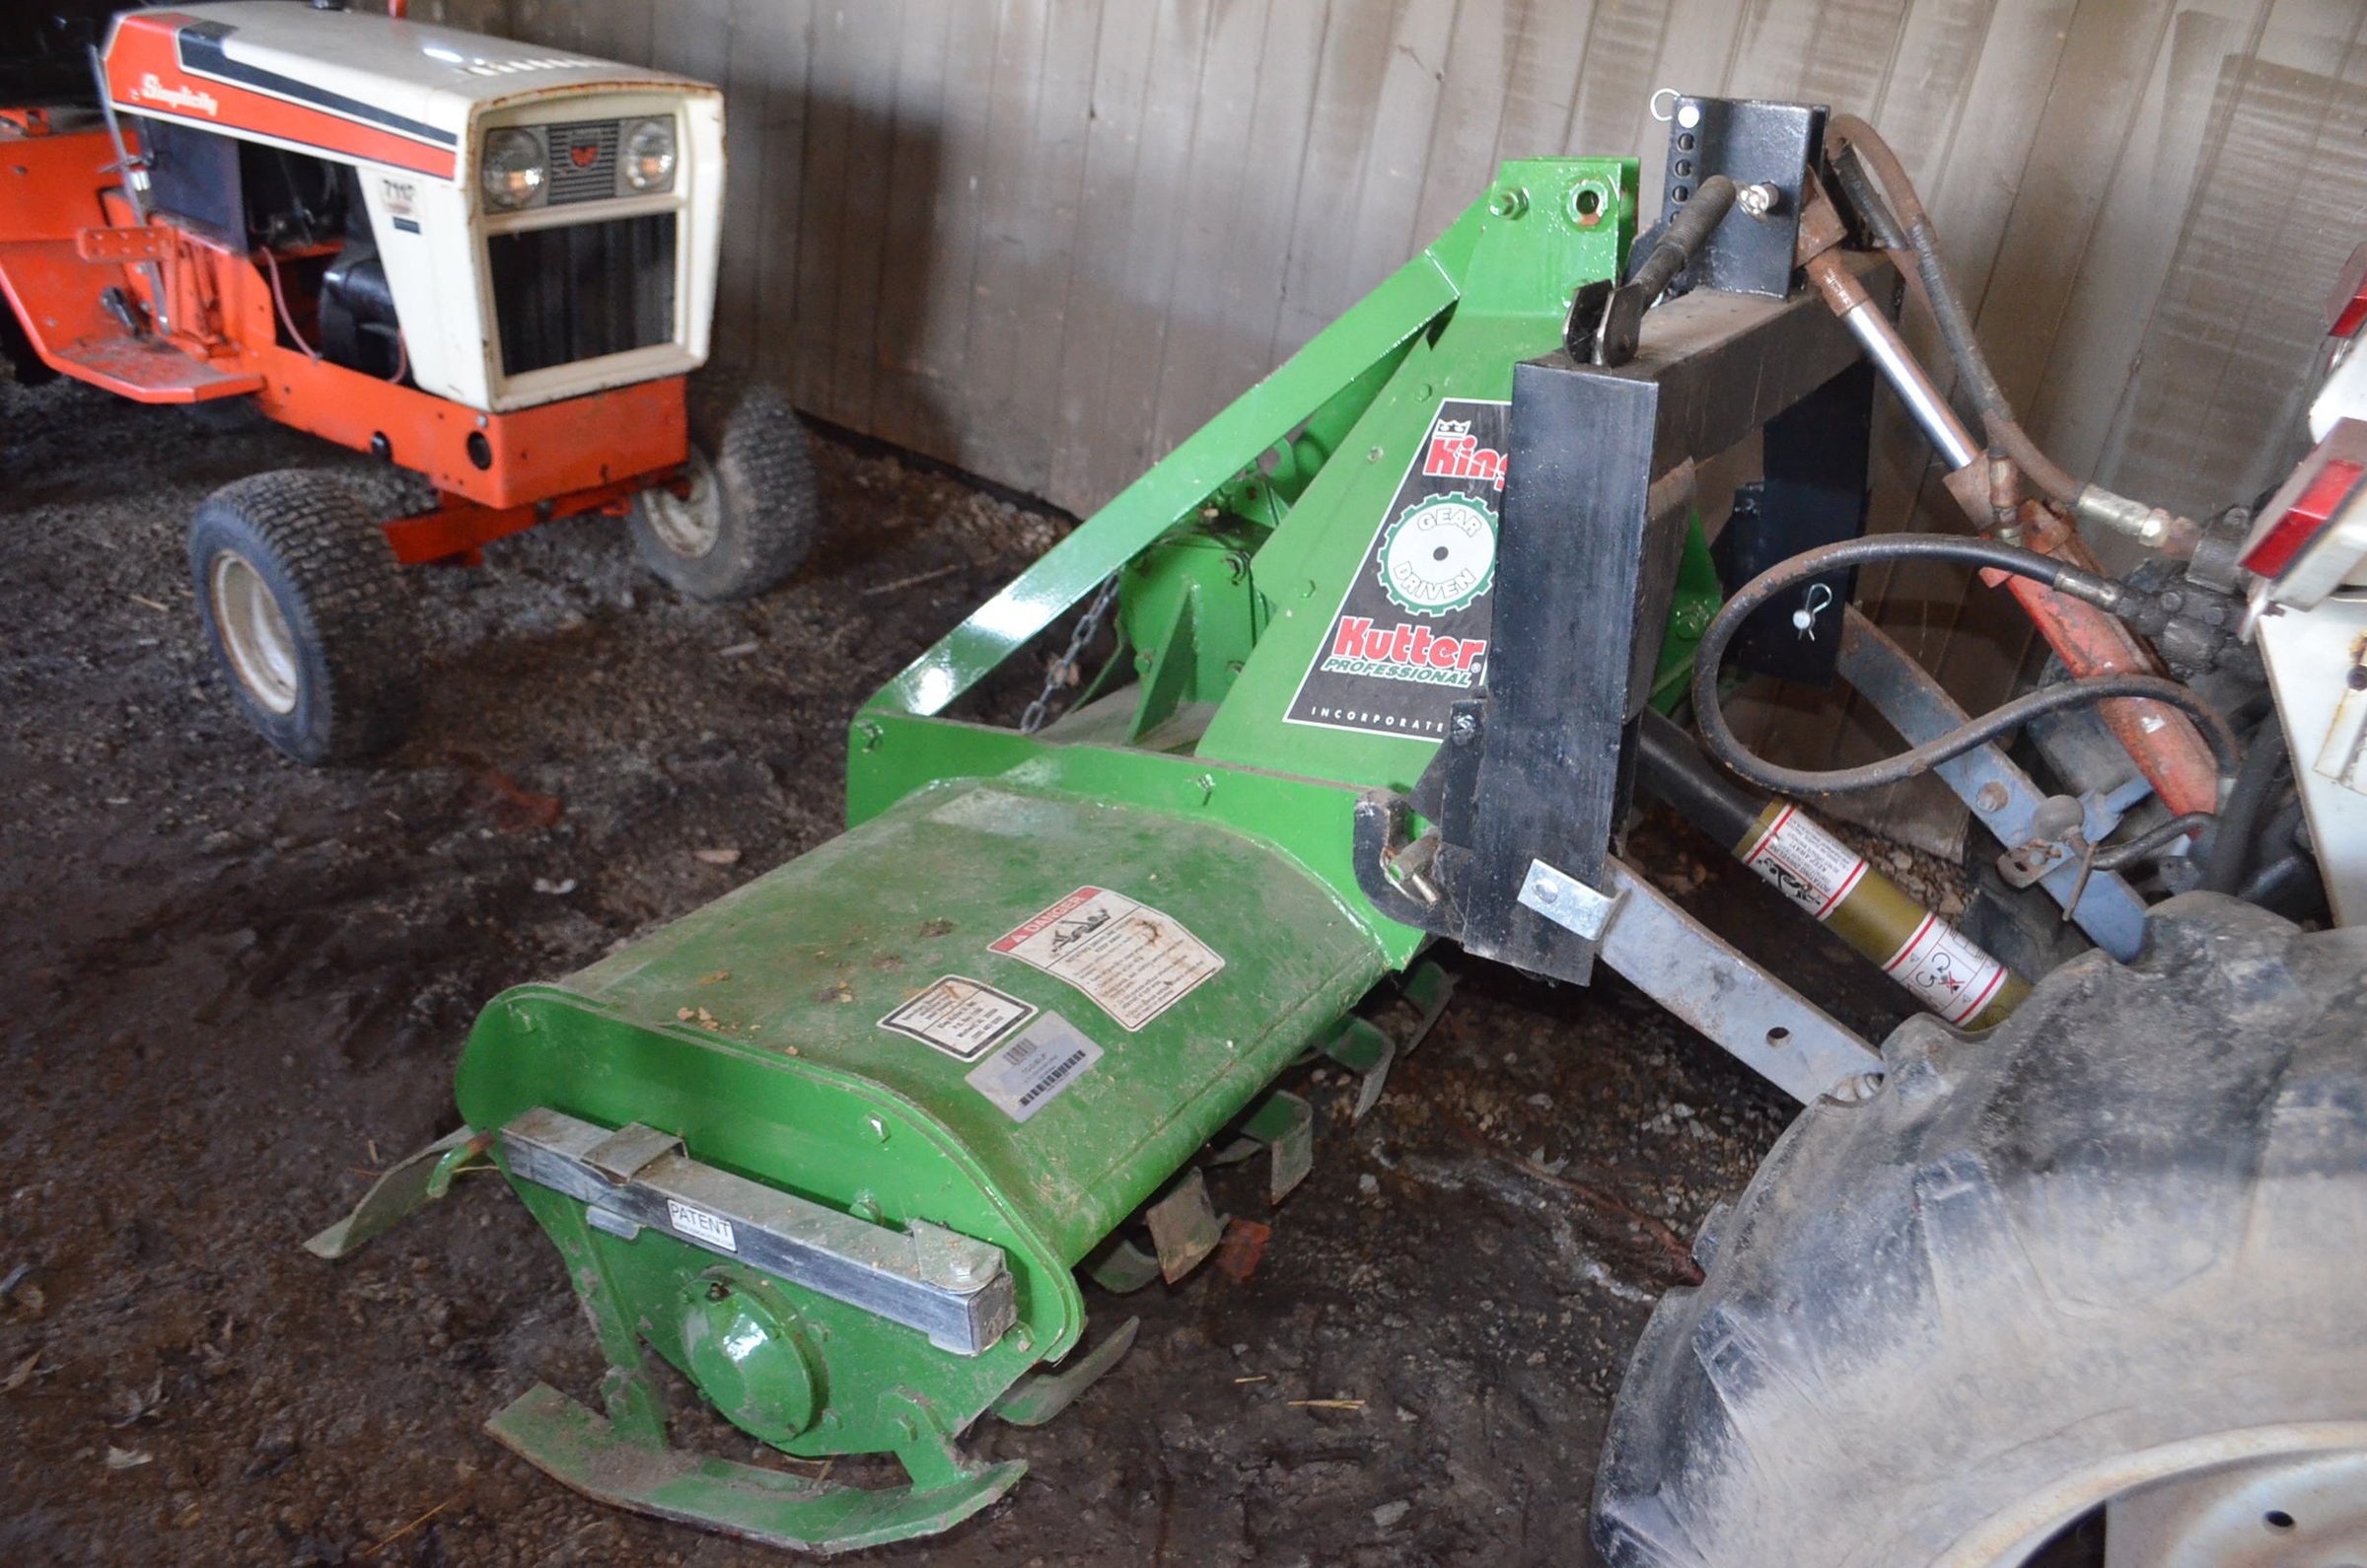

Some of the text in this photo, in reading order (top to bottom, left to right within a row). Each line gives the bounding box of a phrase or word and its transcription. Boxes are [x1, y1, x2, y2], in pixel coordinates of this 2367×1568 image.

[141, 73, 218, 116] Simplicity
[1418, 508, 1481, 537] GEAR
[1394, 561, 1475, 600] DRIVEN
[1332, 616, 1486, 671] Kutter
[1322, 658, 1471, 687] PROFESSIONAL
[1024, 896, 1086, 932] DANGER
[671, 1203, 730, 1238] PATENT
